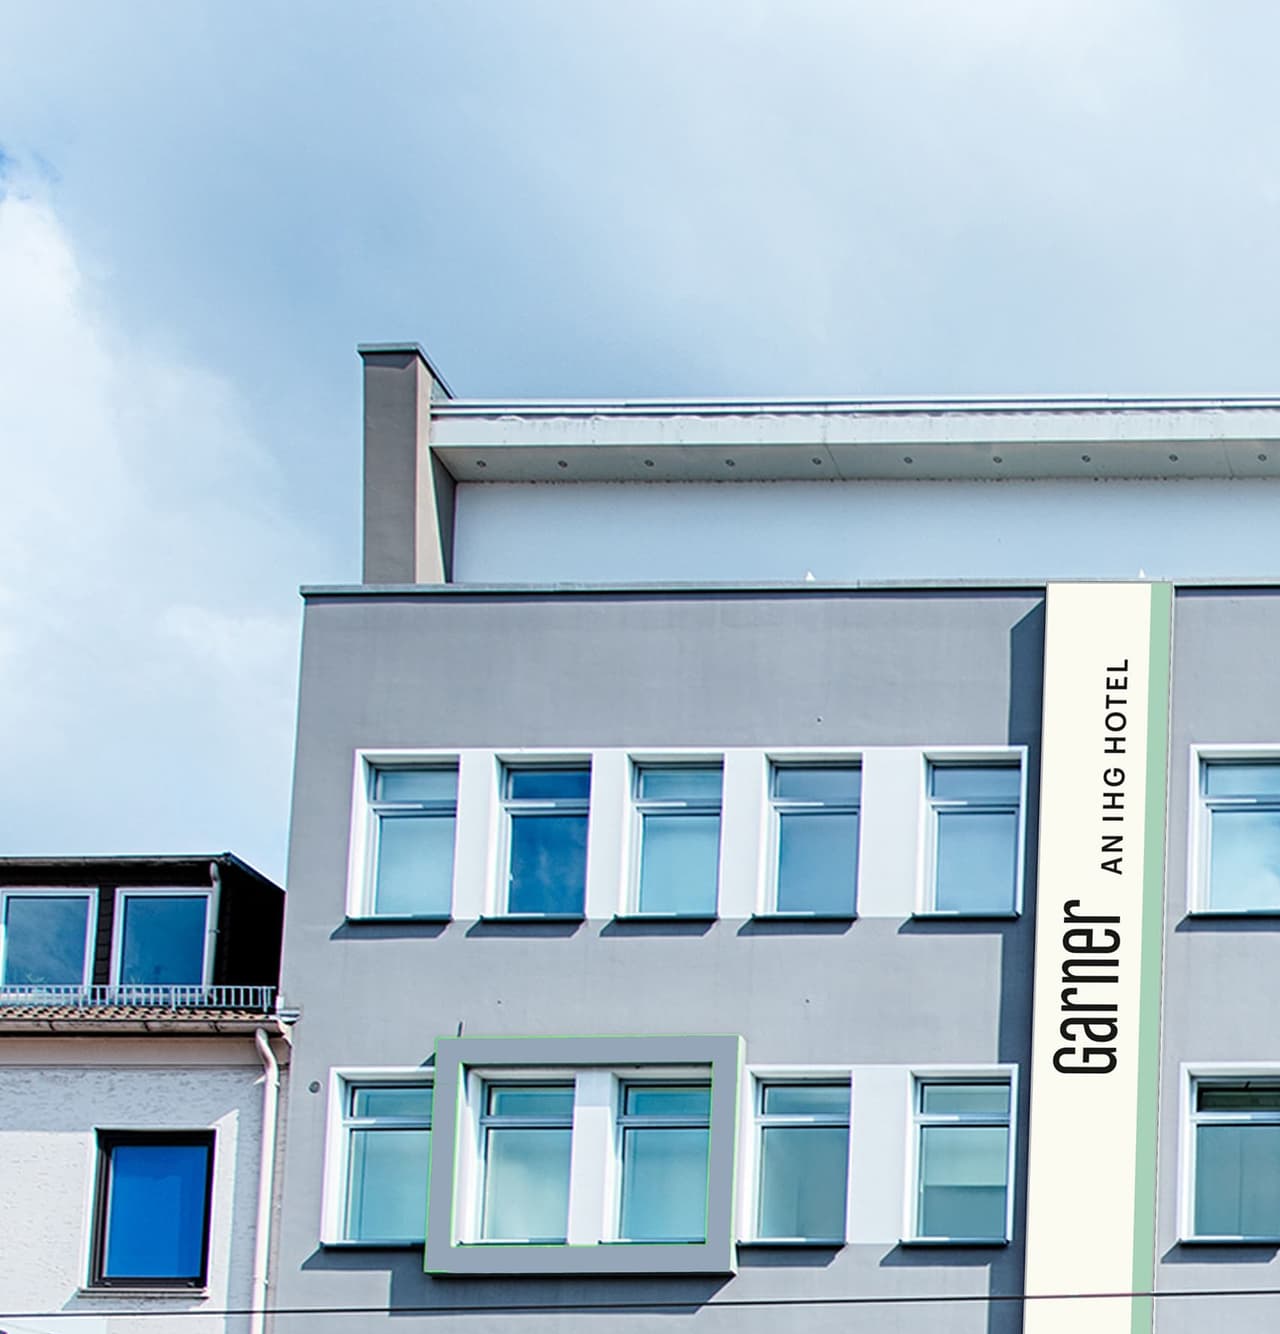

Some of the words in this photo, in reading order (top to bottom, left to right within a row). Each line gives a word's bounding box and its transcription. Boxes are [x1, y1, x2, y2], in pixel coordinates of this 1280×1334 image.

[1103, 658, 1129, 754] HOTEL
[1102, 767, 1126, 822] IHG
[1100, 835, 1124, 876] AN
[1053, 899, 1121, 1075] Garner
